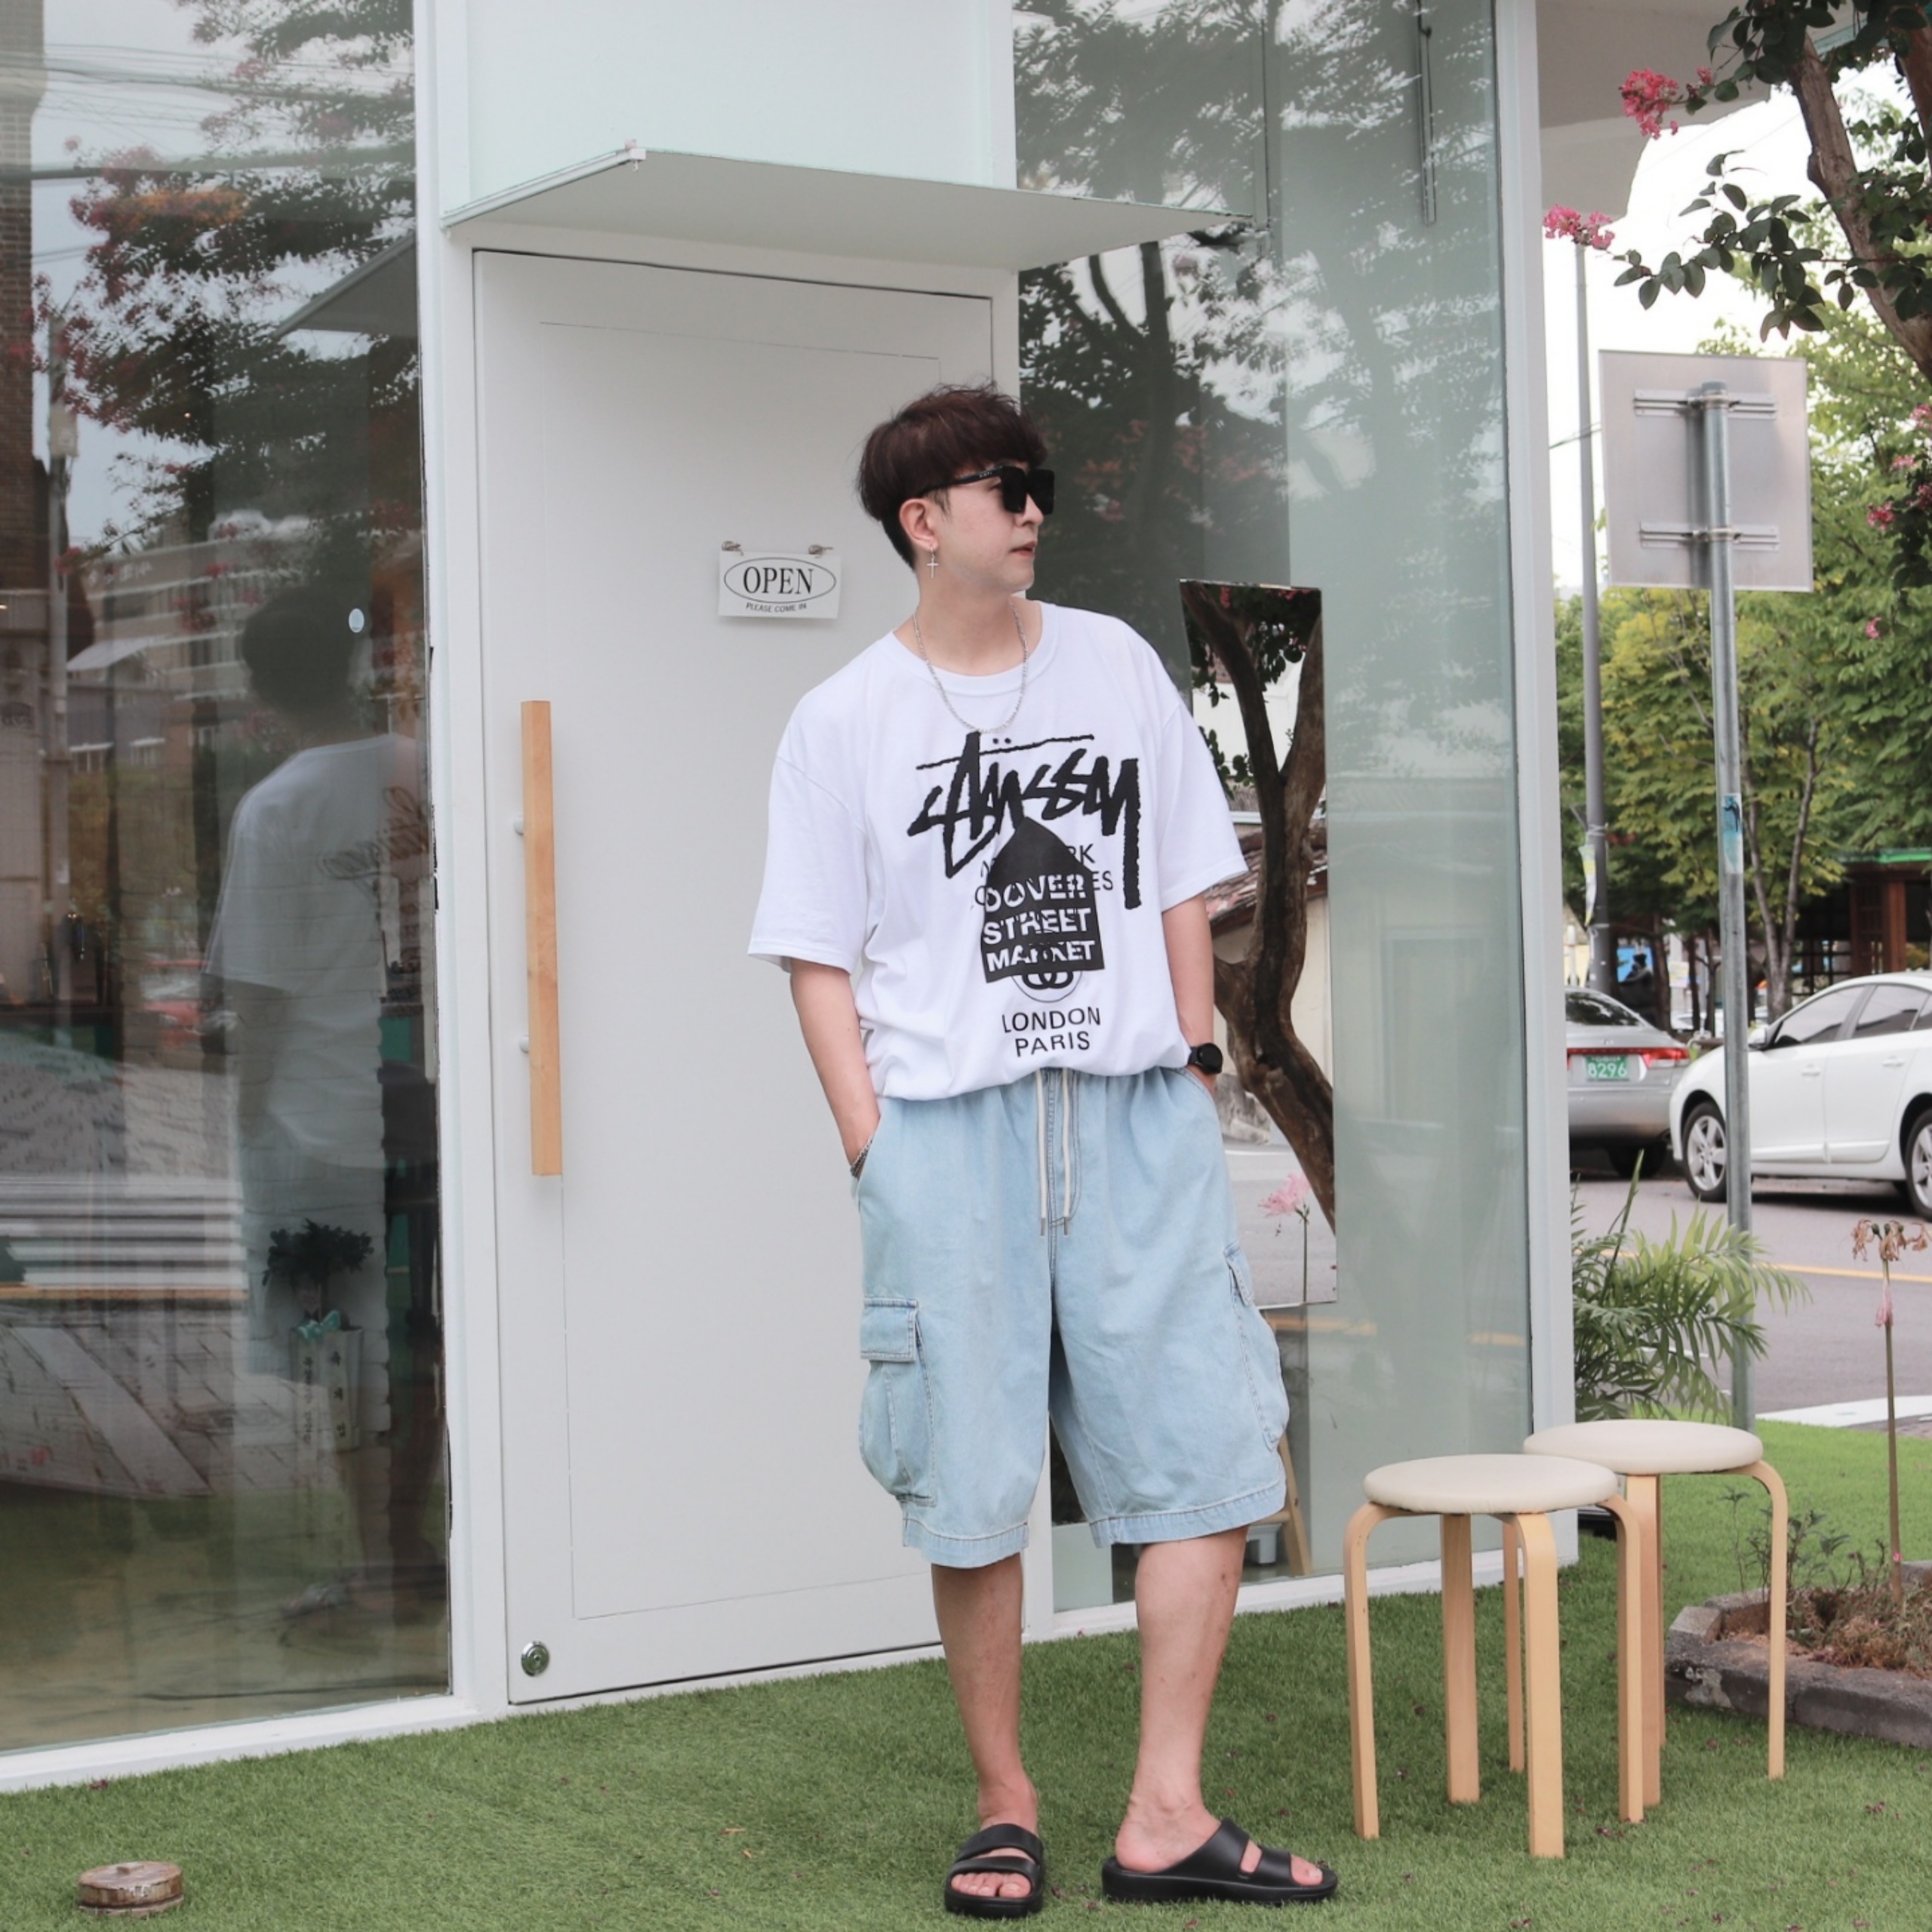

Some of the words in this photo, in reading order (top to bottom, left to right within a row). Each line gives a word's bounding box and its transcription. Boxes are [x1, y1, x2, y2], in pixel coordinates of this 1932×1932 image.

[743, 566, 814, 595] OPEN
[746, 601, 772, 613] PLEASE
[774, 605, 796, 613] COME
[983, 908, 1091, 944] STREET
[1001, 1006, 1100, 1033] LONDON
[1015, 1030, 1091, 1057] PARIS
[1588, 1062, 1627, 1078] 8296
